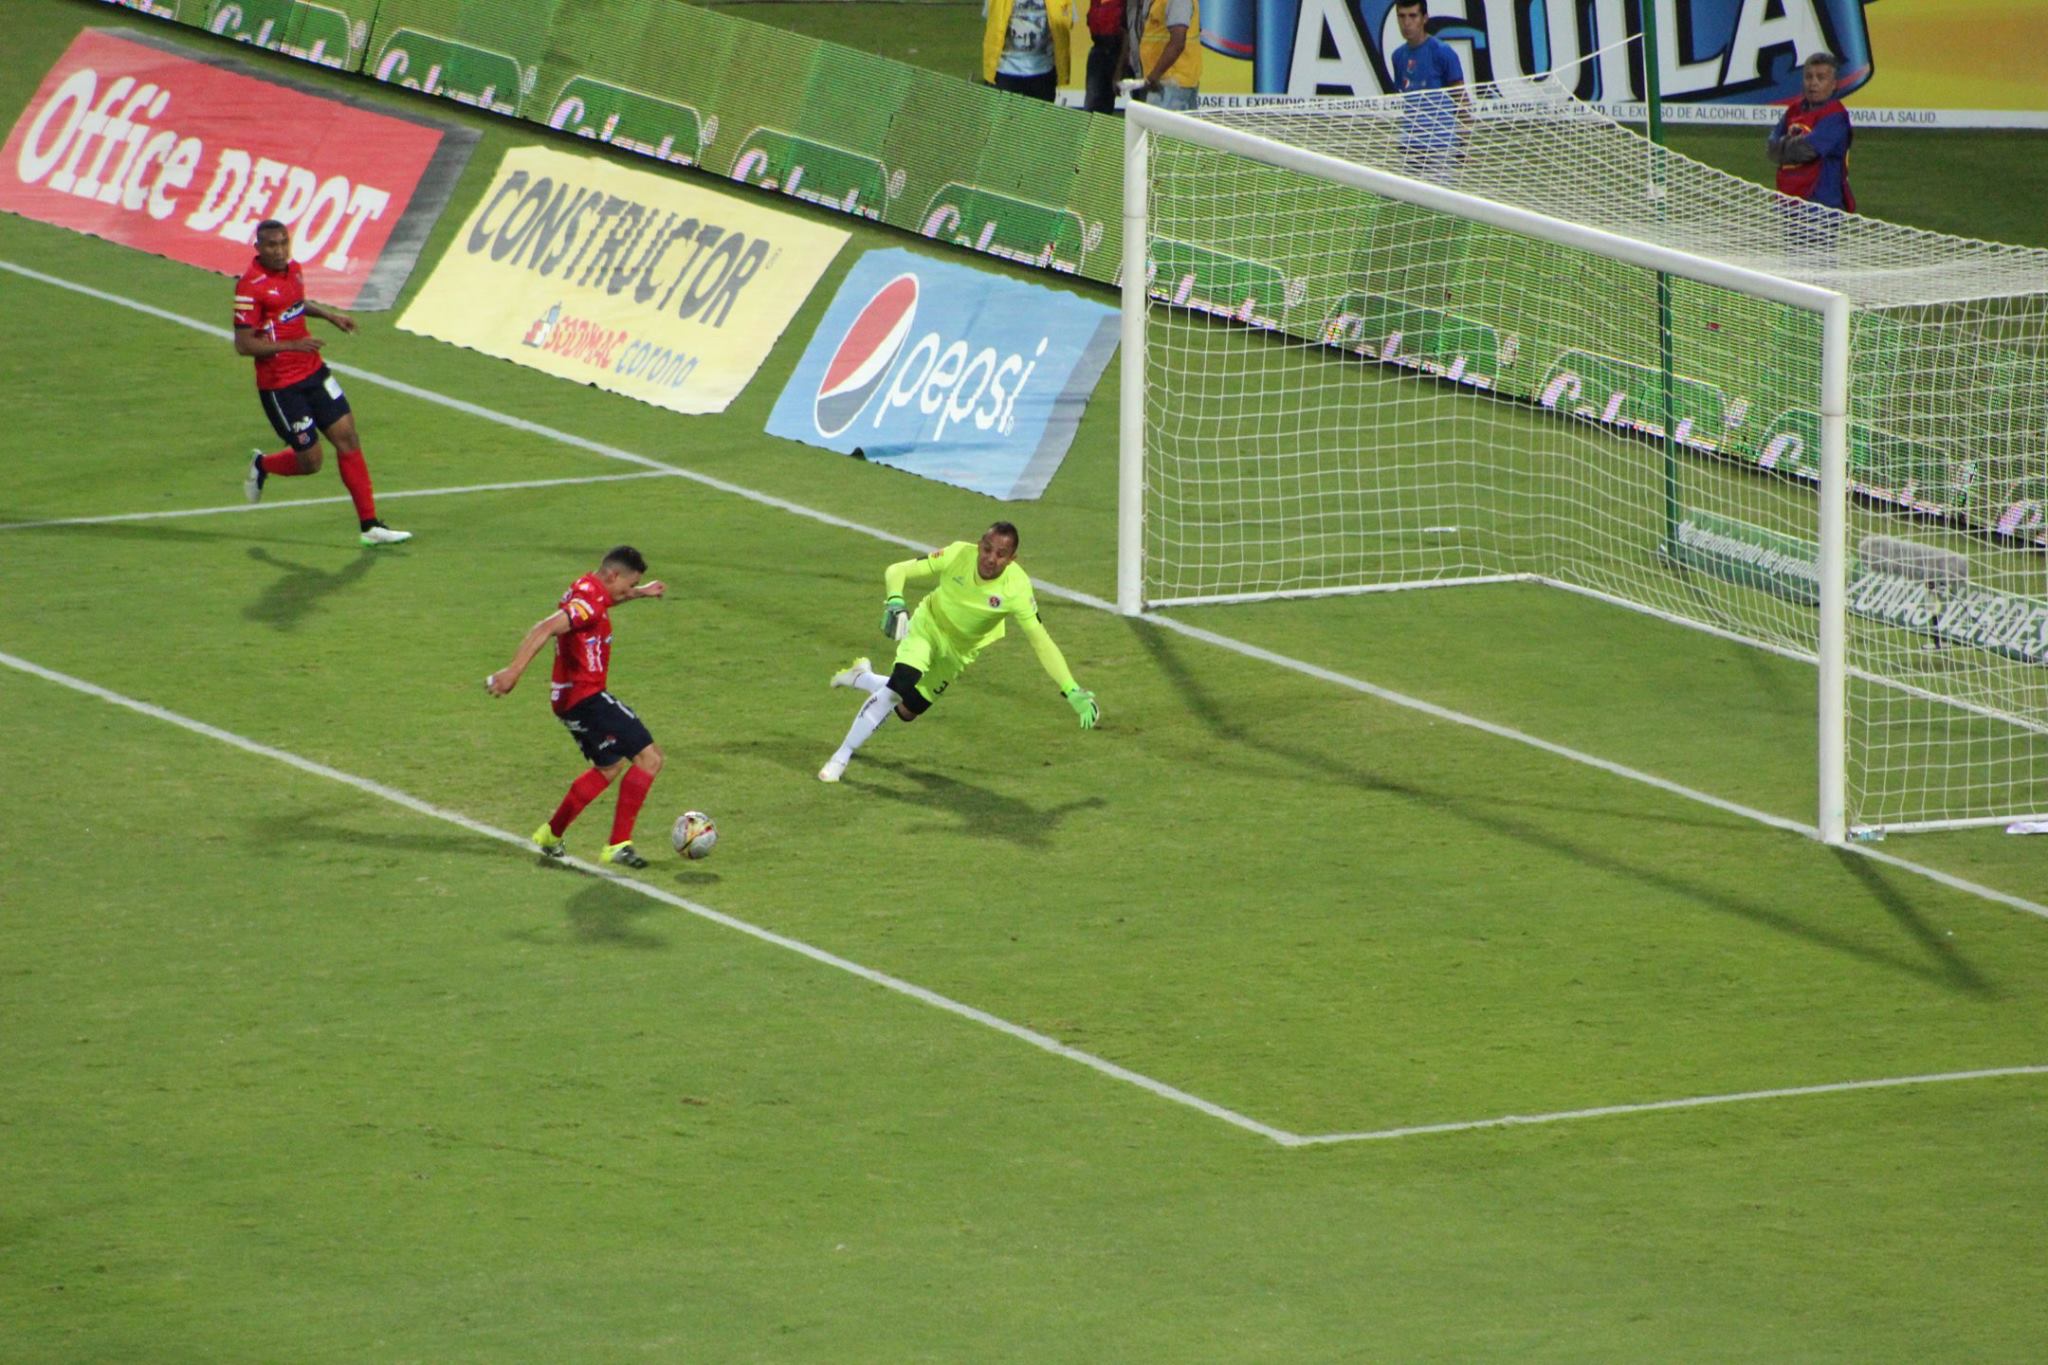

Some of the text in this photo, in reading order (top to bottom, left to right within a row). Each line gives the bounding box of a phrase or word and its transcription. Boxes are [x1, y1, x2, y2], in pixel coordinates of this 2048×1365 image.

[1612, 104, 1624, 117] EL
[1629, 105, 1674, 118] EXCSO
[1677, 106, 1692, 119] DE
[1695, 107, 1749, 119] ALCOHOL
[1753, 108, 1767, 120] ES
[1880, 111, 1894, 122] LA
[18, 68, 391, 272] Office DEPOT
[467, 170, 771, 331] CONSTRUCTOR
